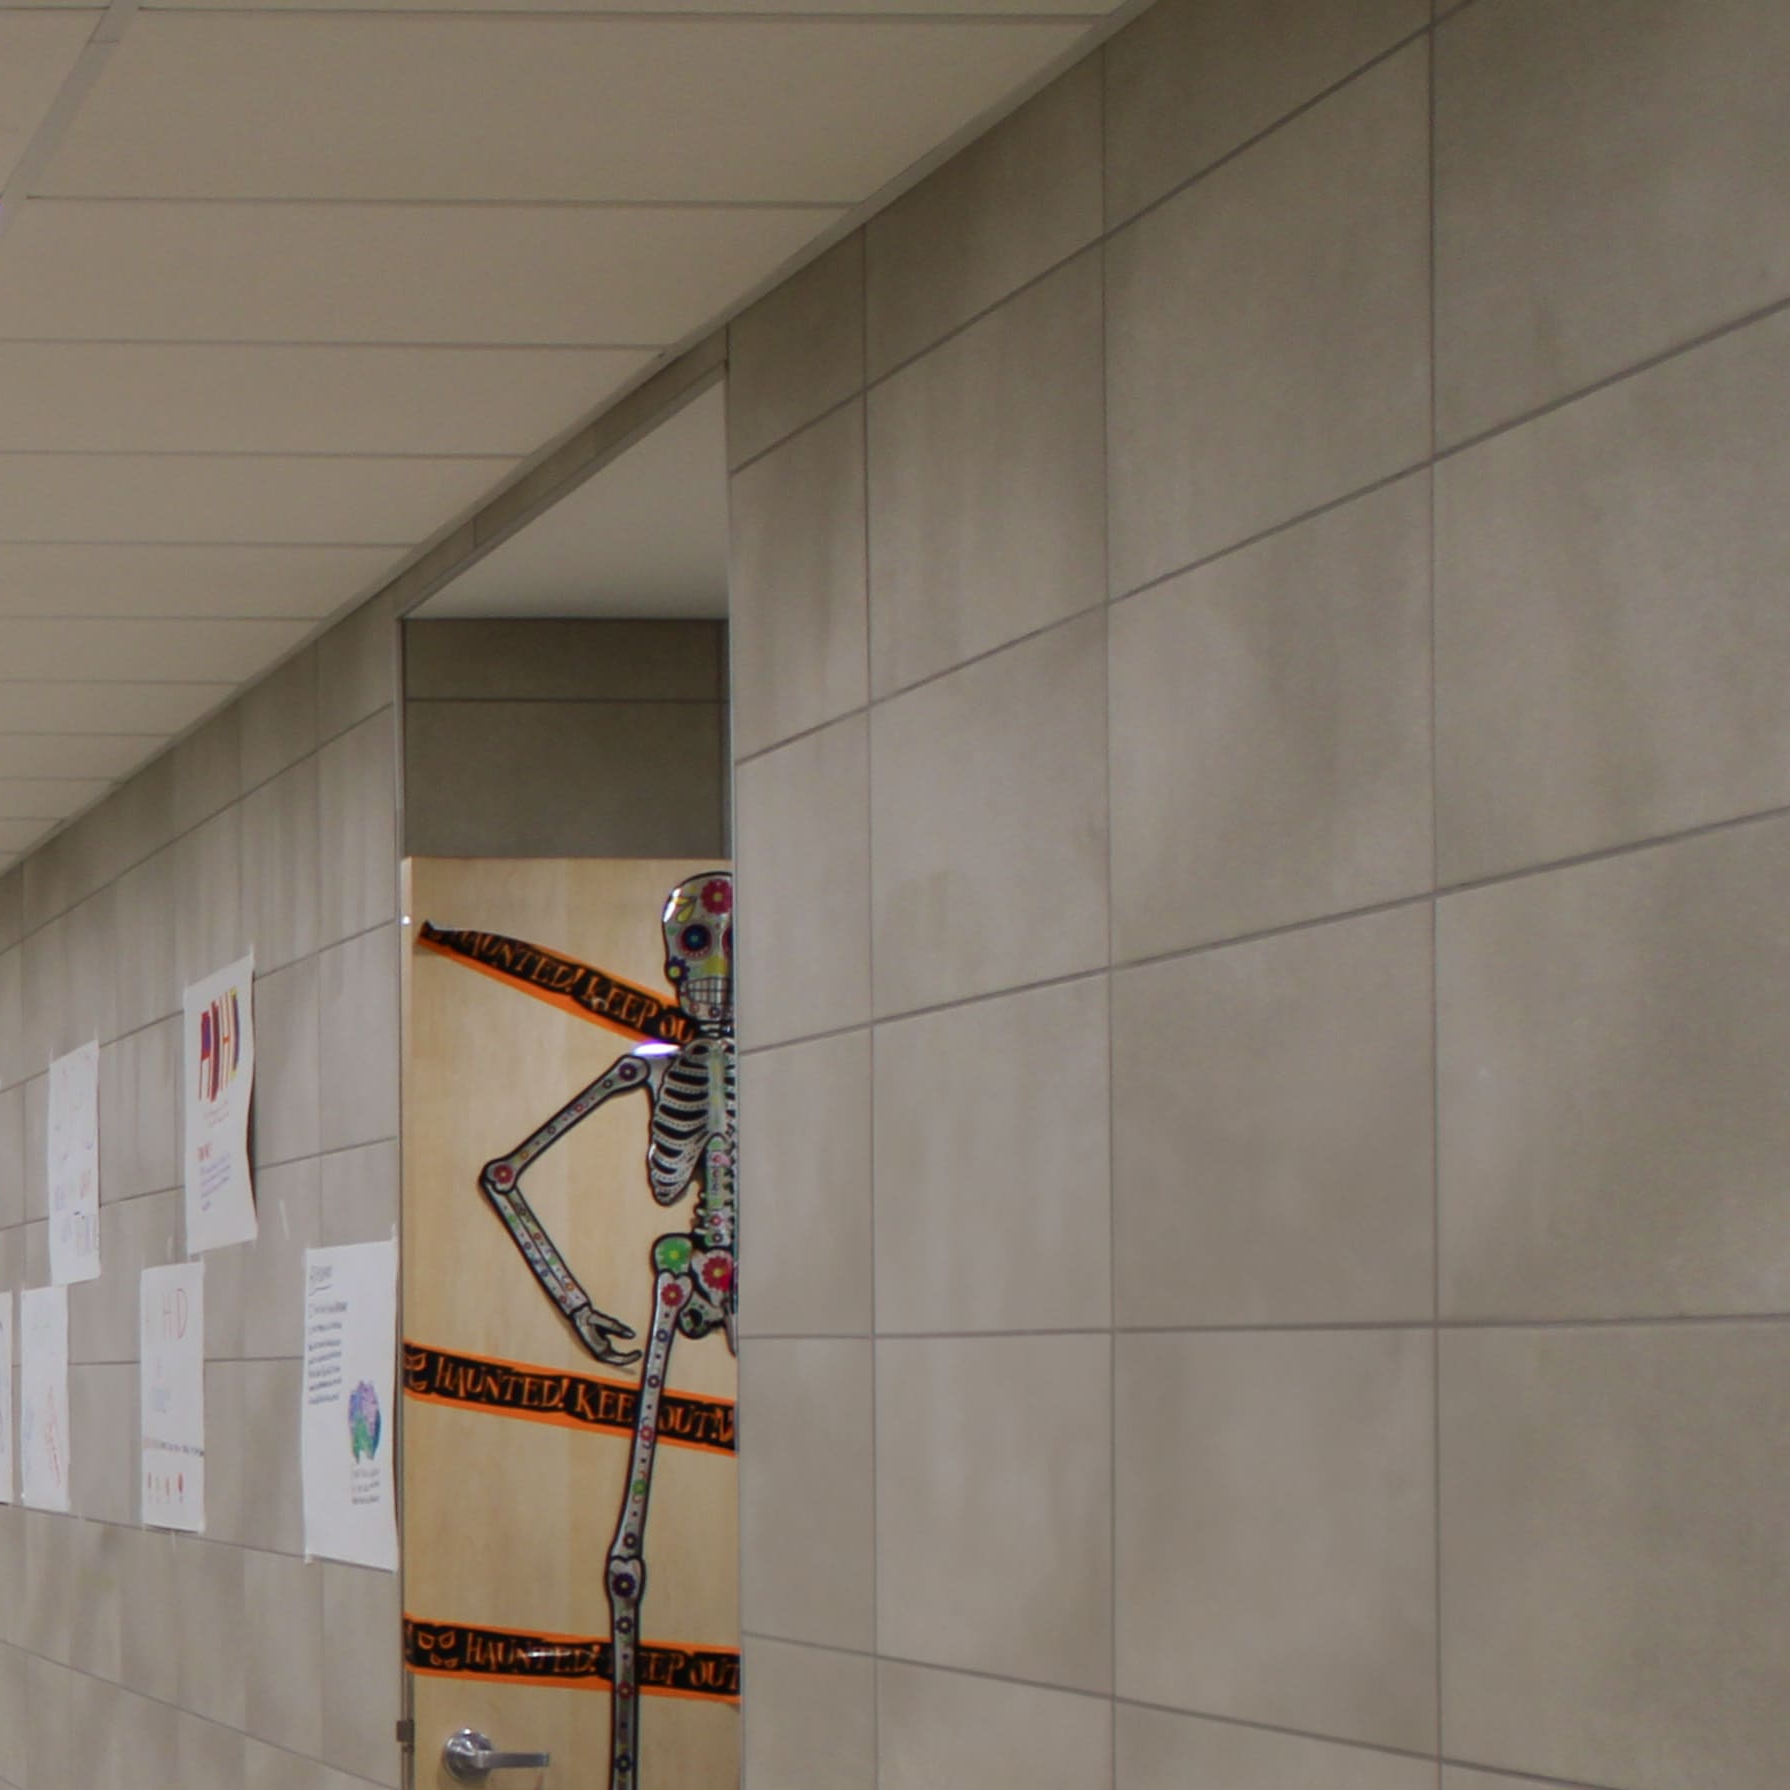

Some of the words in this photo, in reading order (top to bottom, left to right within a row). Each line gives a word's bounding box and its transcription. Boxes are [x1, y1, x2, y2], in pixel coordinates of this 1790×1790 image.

[582, 976, 658, 1029] KEEP
[435, 1356, 569, 1409] HAUNTED!
[574, 1383, 635, 1424] KEE
[465, 1631, 602, 1674] HAUNTED!
